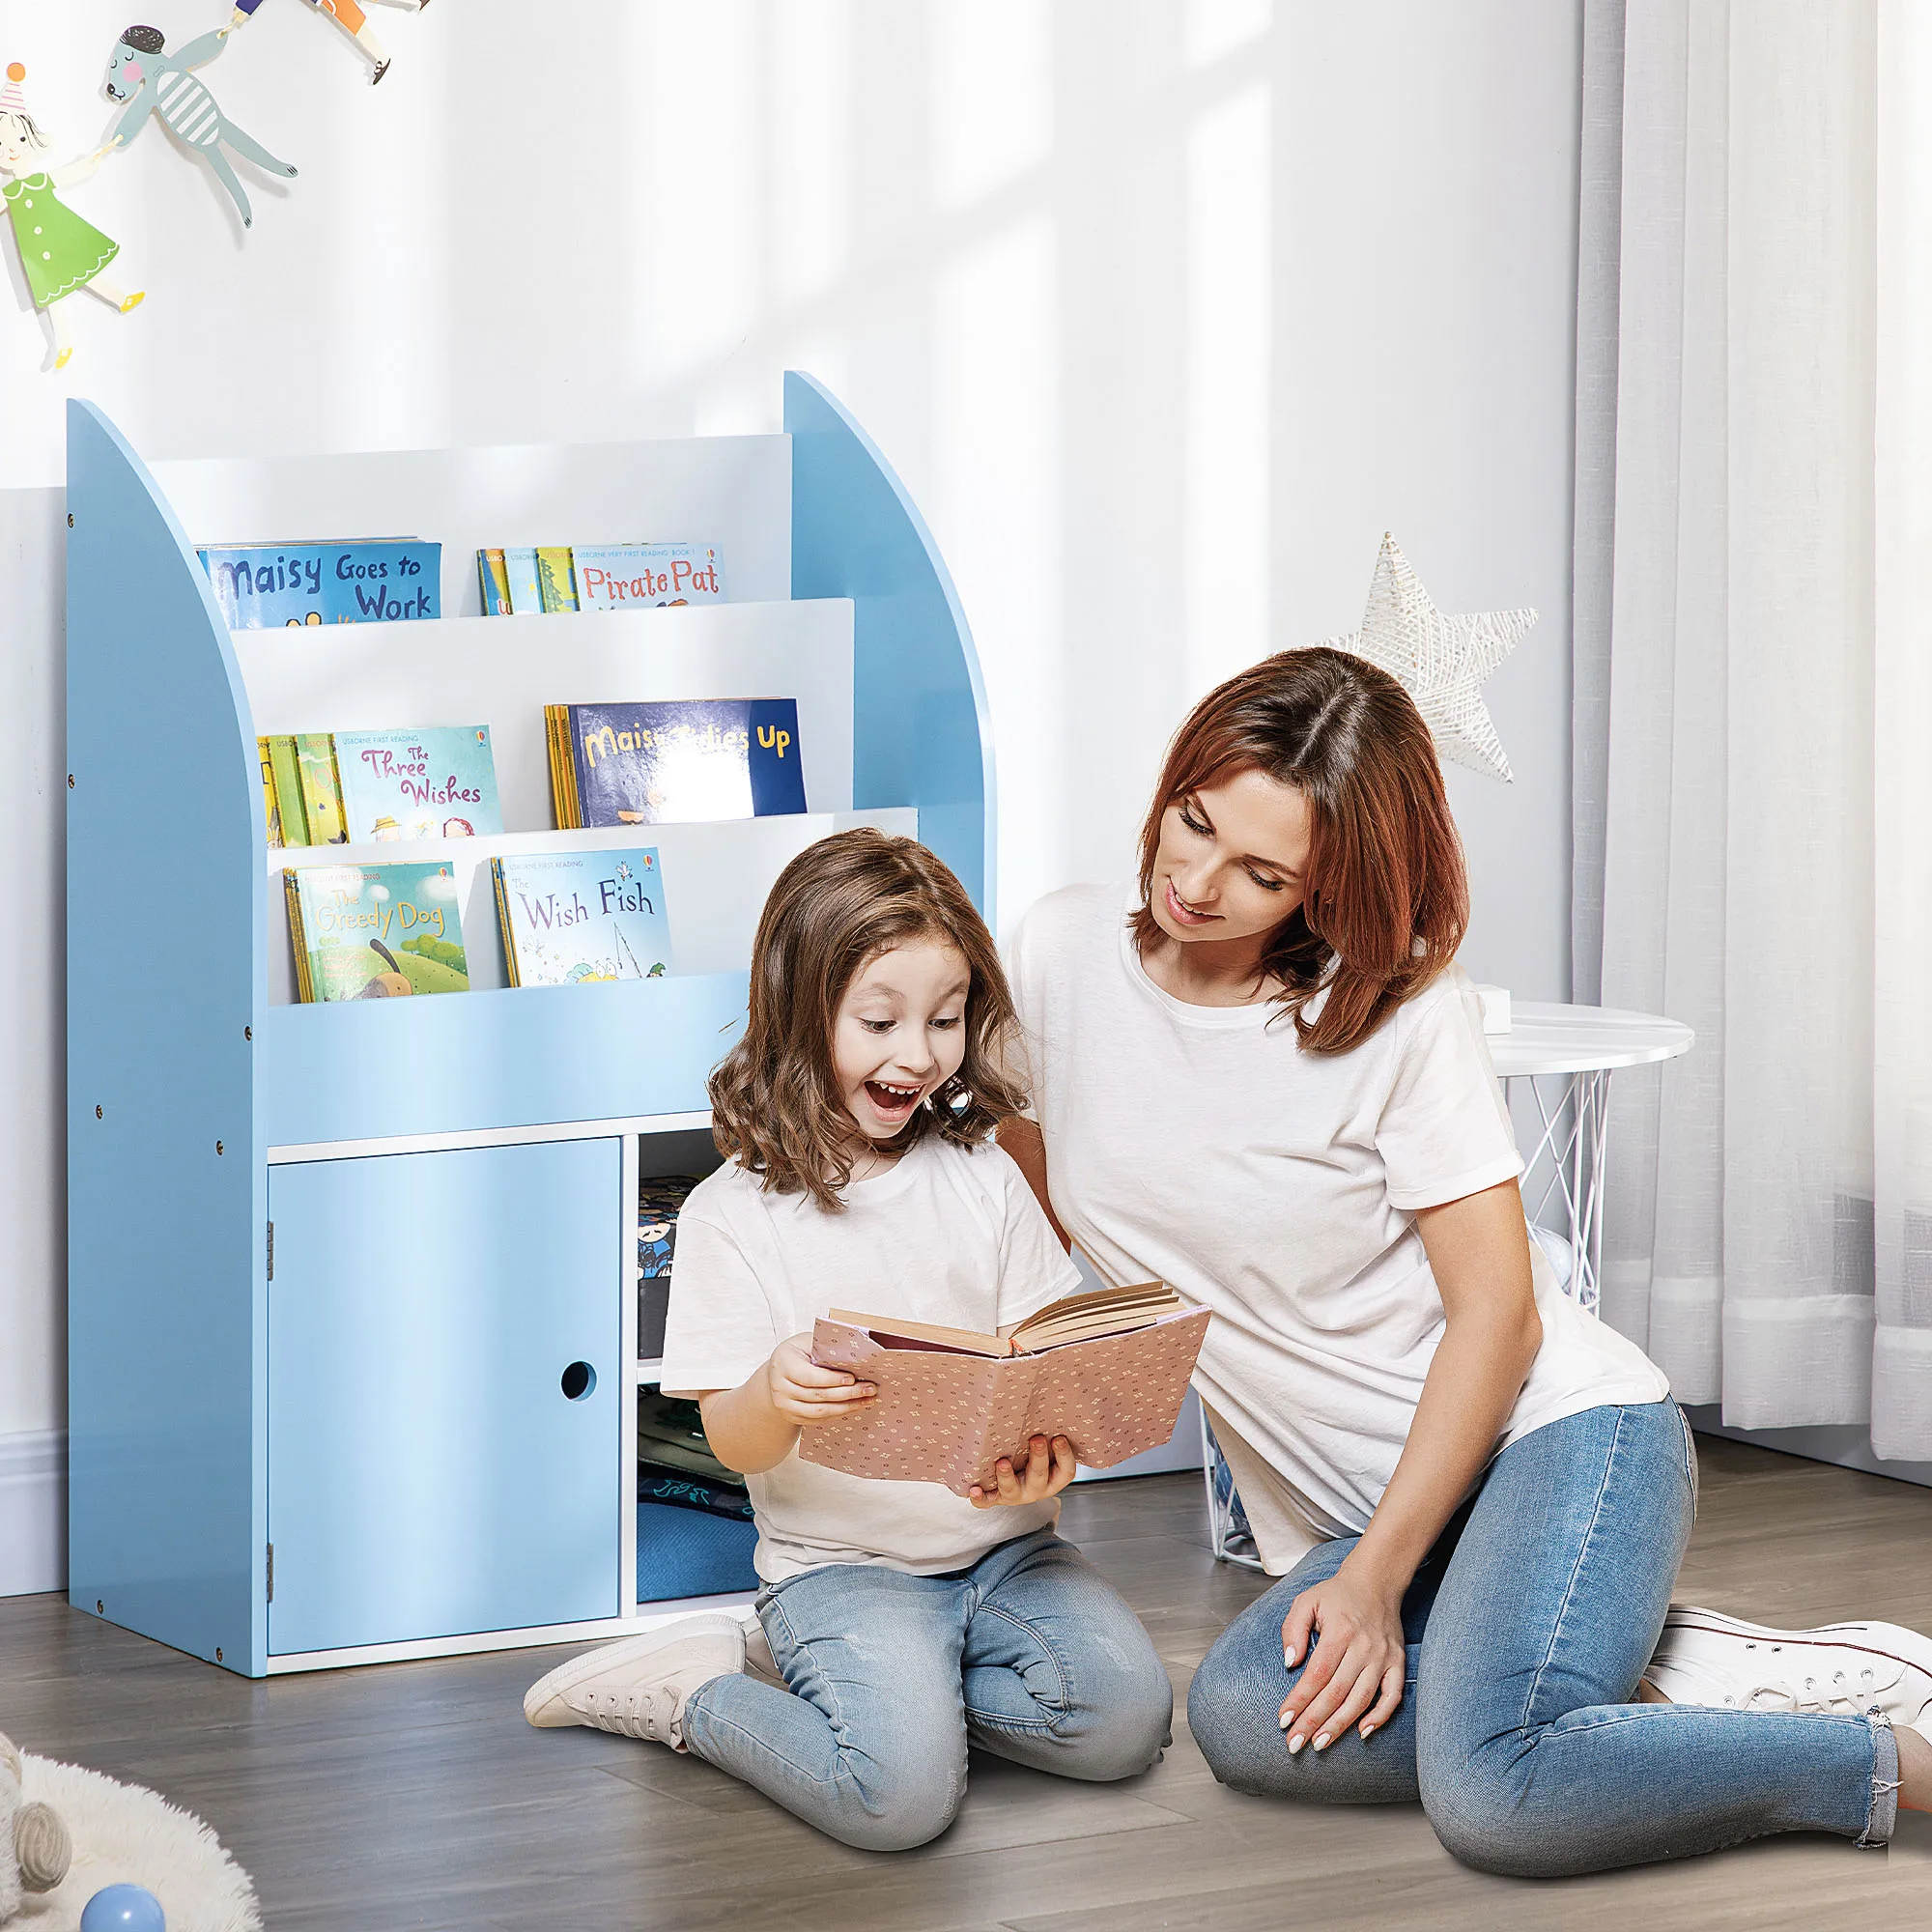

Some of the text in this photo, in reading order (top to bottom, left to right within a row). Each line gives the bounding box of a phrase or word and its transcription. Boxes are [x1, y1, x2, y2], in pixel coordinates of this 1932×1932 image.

[217, 555, 322, 601] Maisy
[335, 554, 421, 581] Goes to
[582, 560, 720, 600] Pirate Pat
[355, 583, 431, 621] Work
[408, 746, 429, 761] The
[756, 724, 791, 758] Up
[361, 750, 426, 779] Three
[401, 775, 481, 808] Wishes
[331, 889, 360, 908] The
[515, 892, 589, 930] Wish
[597, 878, 656, 916] Fish
[315, 901, 393, 939] Greedy
[397, 901, 445, 938] Dog
